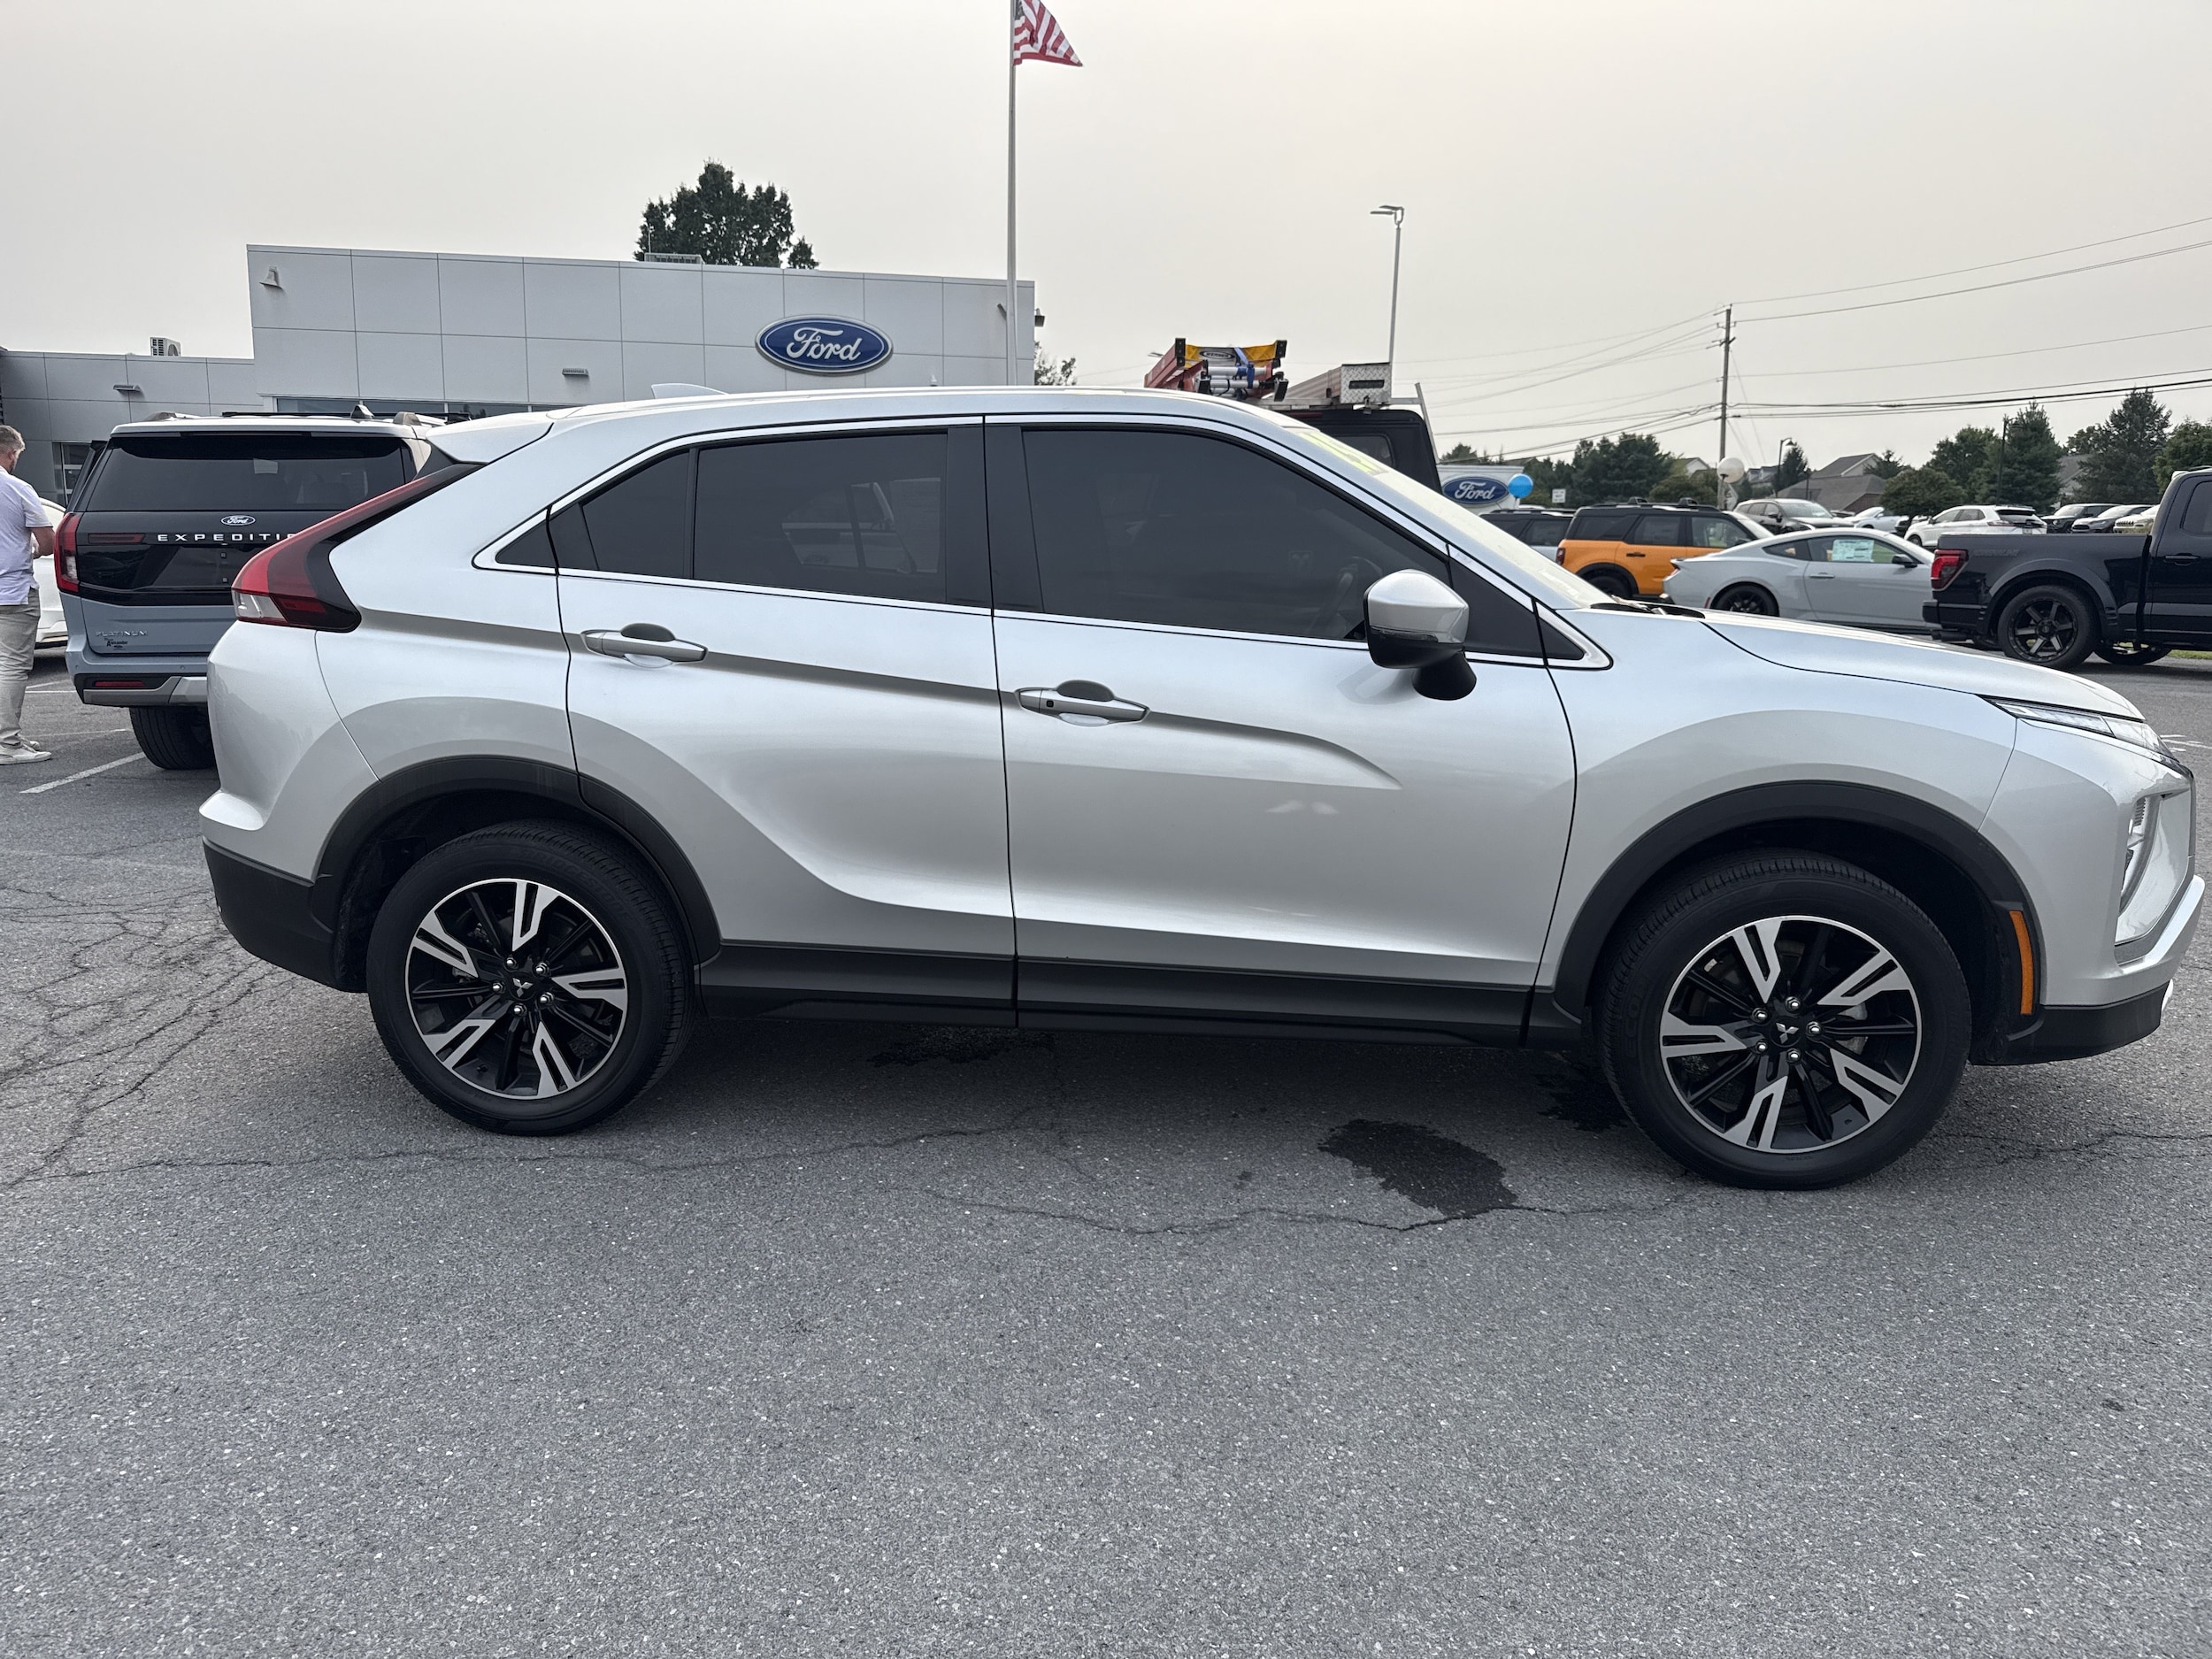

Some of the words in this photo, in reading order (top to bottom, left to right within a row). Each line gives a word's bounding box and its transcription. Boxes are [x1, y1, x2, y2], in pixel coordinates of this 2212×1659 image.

[786, 326, 863, 362] Ford
[1454, 480, 1496, 500] Ford
[227, 515, 250, 525] Ford
